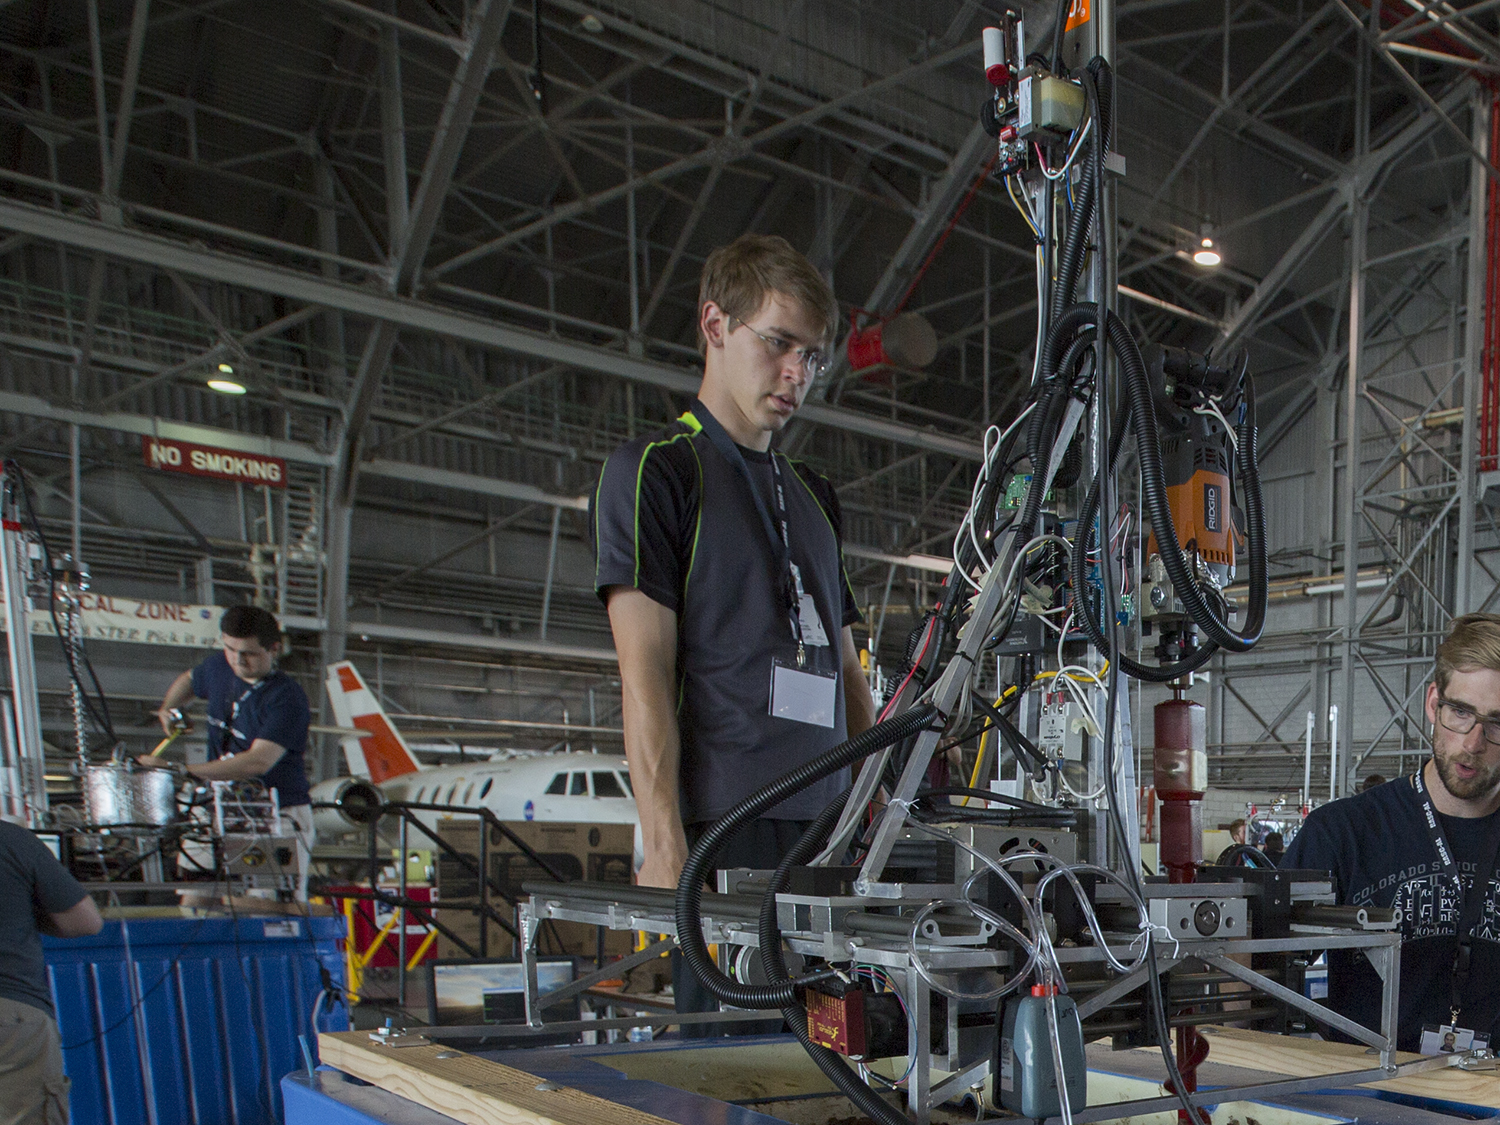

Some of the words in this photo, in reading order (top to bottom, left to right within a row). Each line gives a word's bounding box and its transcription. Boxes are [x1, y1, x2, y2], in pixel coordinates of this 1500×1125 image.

[150, 443, 182, 466] NO
[190, 450, 282, 482] SMOKING
[1208, 488, 1216, 529] RIDGID
[135, 601, 192, 623] ZONE
[1353, 863, 1426, 905] COLORADO
